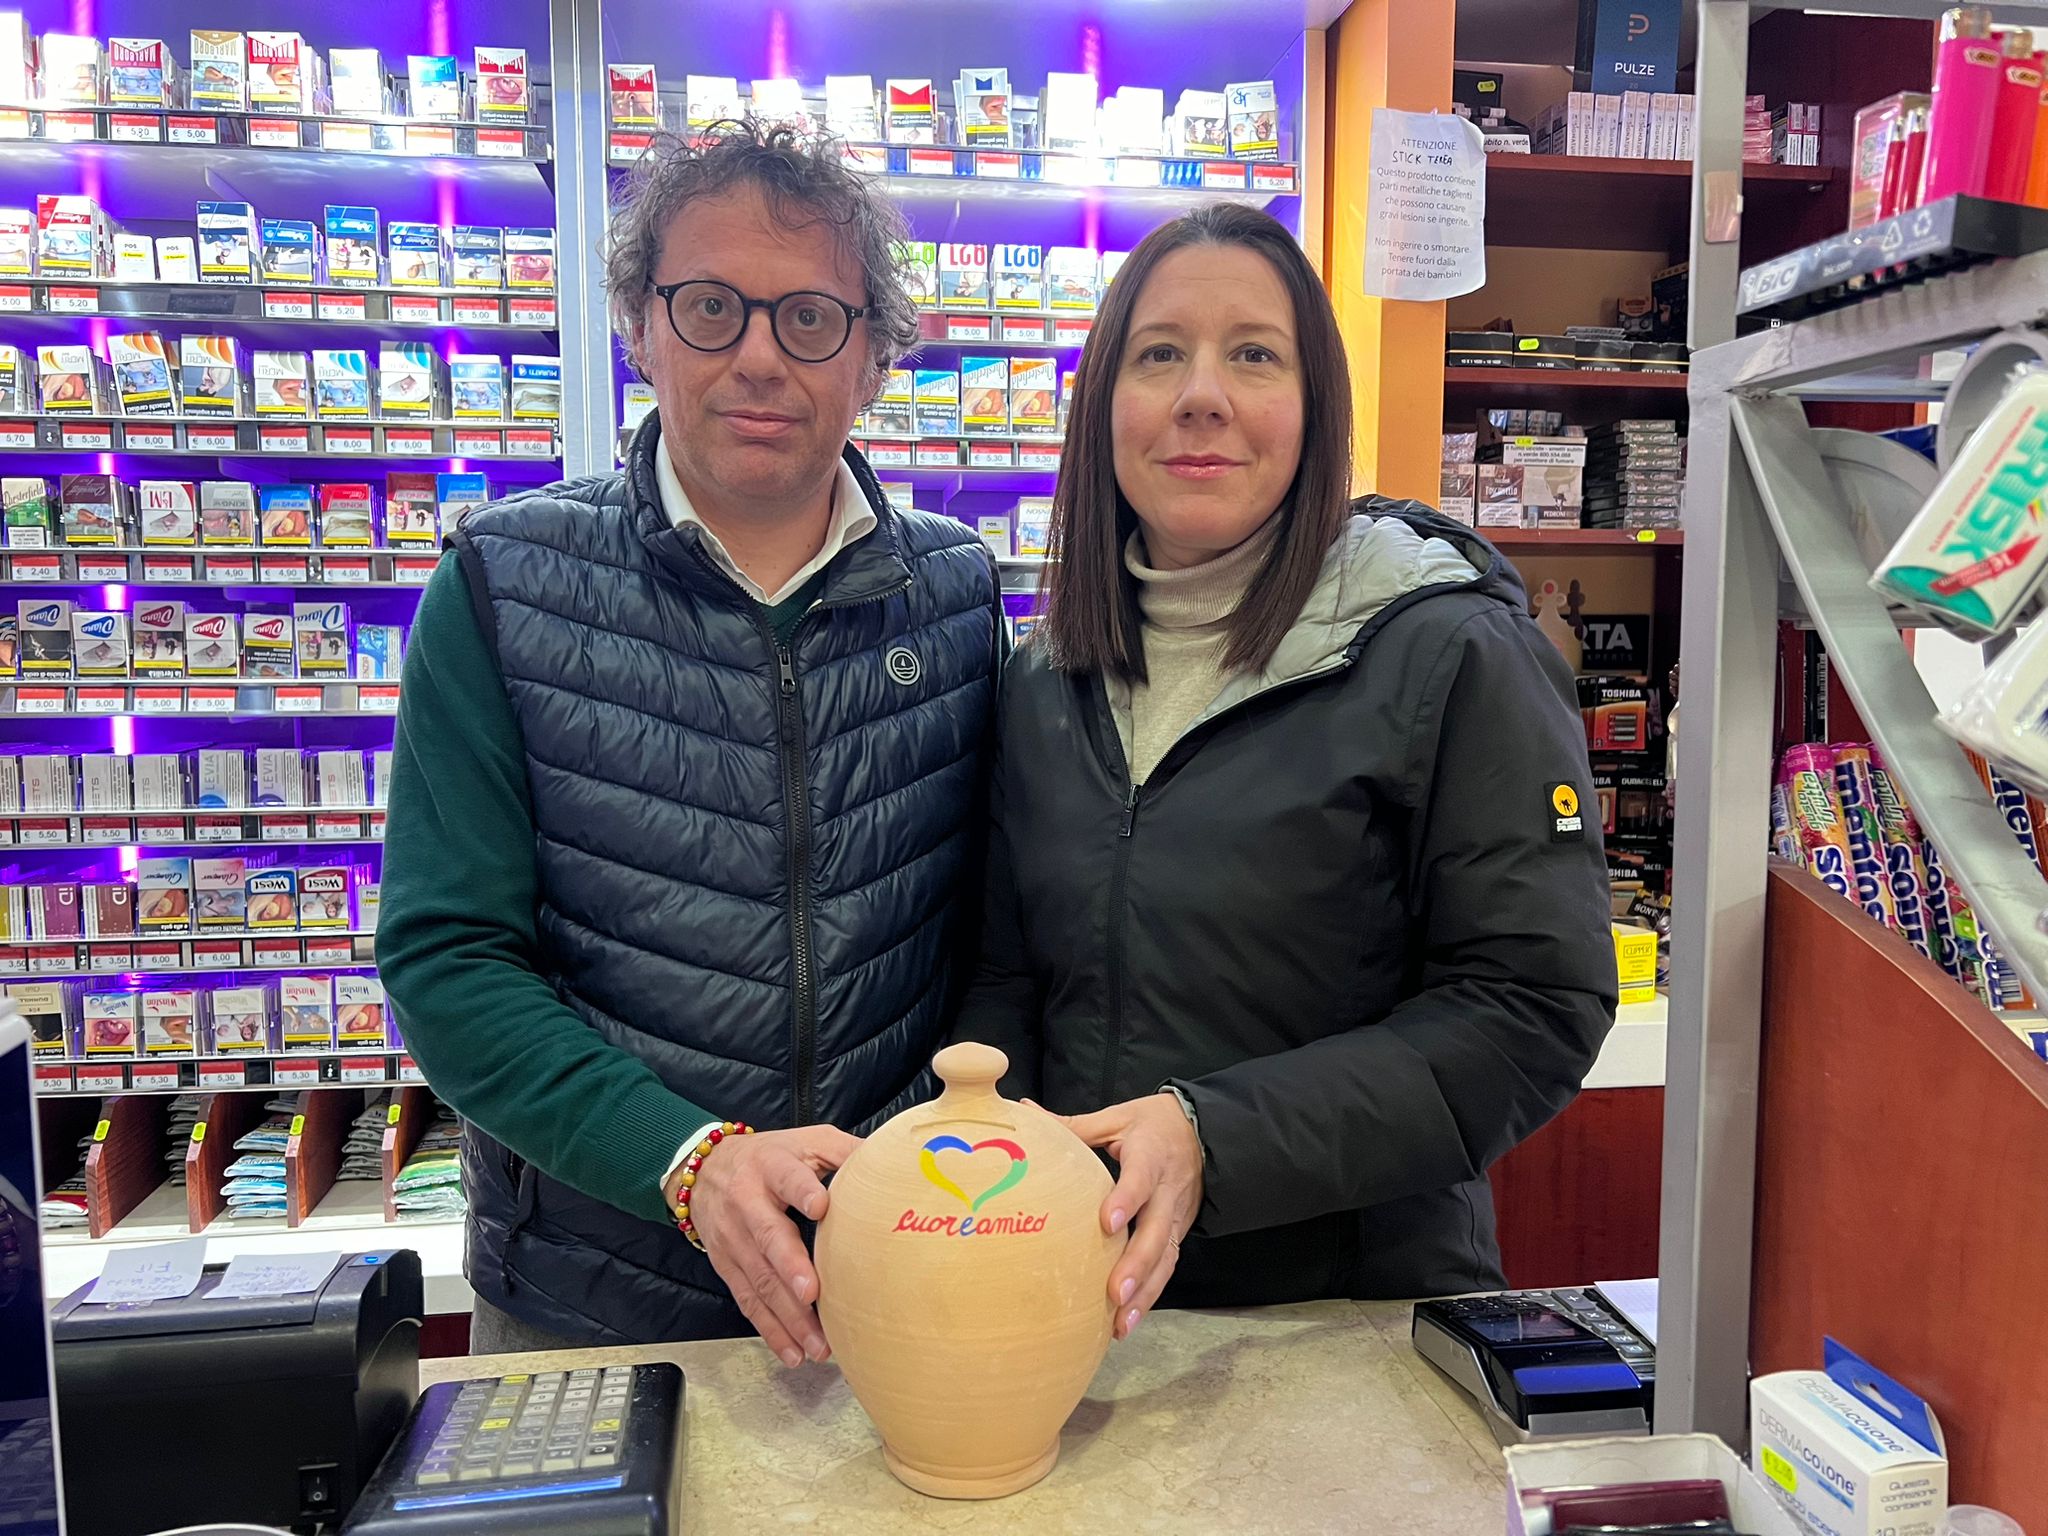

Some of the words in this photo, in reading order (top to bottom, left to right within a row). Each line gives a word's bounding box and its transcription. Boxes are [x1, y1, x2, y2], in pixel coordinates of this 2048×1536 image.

[1614, 62, 1656, 76] PULZE
[187, 130, 206, 138] 5,00
[1401, 138, 1456, 151] ATTENZIONE
[1512, 138, 1529, 147] verde
[1392, 151, 1422, 165] STICK
[1376, 167, 1406, 178] Questo
[1407, 170, 1443, 184] prodotto
[1444, 176, 1477, 187] contiene
[1379, 181, 1399, 192] parti
[1400, 184, 1441, 196] metalliche
[1442, 189, 1473, 201] taglienti
[1384, 195, 1399, 205] che
[1400, 200, 1435, 211] possono
[1436, 202, 1466, 213] causare
[1379, 210, 1399, 222] gravi
[1400, 212, 1426, 223] lesioni
[1427, 216, 1437, 224] se
[1375, 237, 1392, 247] Non
[1392, 238, 1422, 251] ingerire
[1389, 253, 1414, 264] Tenere
[1415, 256, 1435, 265] fuori
[1436, 257, 1456, 266] dalla
[1381, 267, 1411, 278] portata
[1412, 269, 1426, 278] dei
[1427, 269, 1462, 279] bambini
[1758, 266, 1795, 294] BIC
[70, 299, 87, 307] 5,20
[284, 305, 302, 313] 5,00
[337, 307, 354, 315] 5,20
[411, 309, 428, 317] 5,00
[1018, 329, 1035, 337] 5,00
[473, 442, 490, 450] 6,40
[525, 443, 542, 451] 6,40
[932, 453, 949, 461] 5,30
[150, 490, 173, 509] L&M
[31, 567, 50, 576] 2,40
[225, 569, 243, 577] 4,90
[27, 606, 58, 624] Diana
[141, 606, 173, 625] Diana
[297, 604, 341, 630] Diana
[81, 617, 114, 636] Diana
[193, 617, 225, 637] Diana
[253, 619, 283, 638] Diana
[1601, 689, 1641, 698] TOSHIBA
[205, 754, 215, 791] LEVIA
[264, 753, 274, 790] LEVIA
[1803, 771, 1837, 826] frutta
[213, 828, 232, 836] 5,50
[254, 879, 287, 890] West
[308, 878, 340, 889] West
[1634, 903, 1659, 916] SONY
[47, 958, 66, 967] 3,50
[212, 953, 231, 962] 6,00
[9, 960, 26, 968] 3,50
[286, 987, 316, 997] Winston
[340, 985, 370, 995] Winston
[146, 998, 177, 1008] Winston
[292, 1071, 310, 1079] 5,30
[358, 1069, 376, 1077] 5,30
[43, 1079, 62, 1087] 5,30
[150, 1076, 169, 1084] 5,30
[1889, 1478, 1930, 1491] Questa
